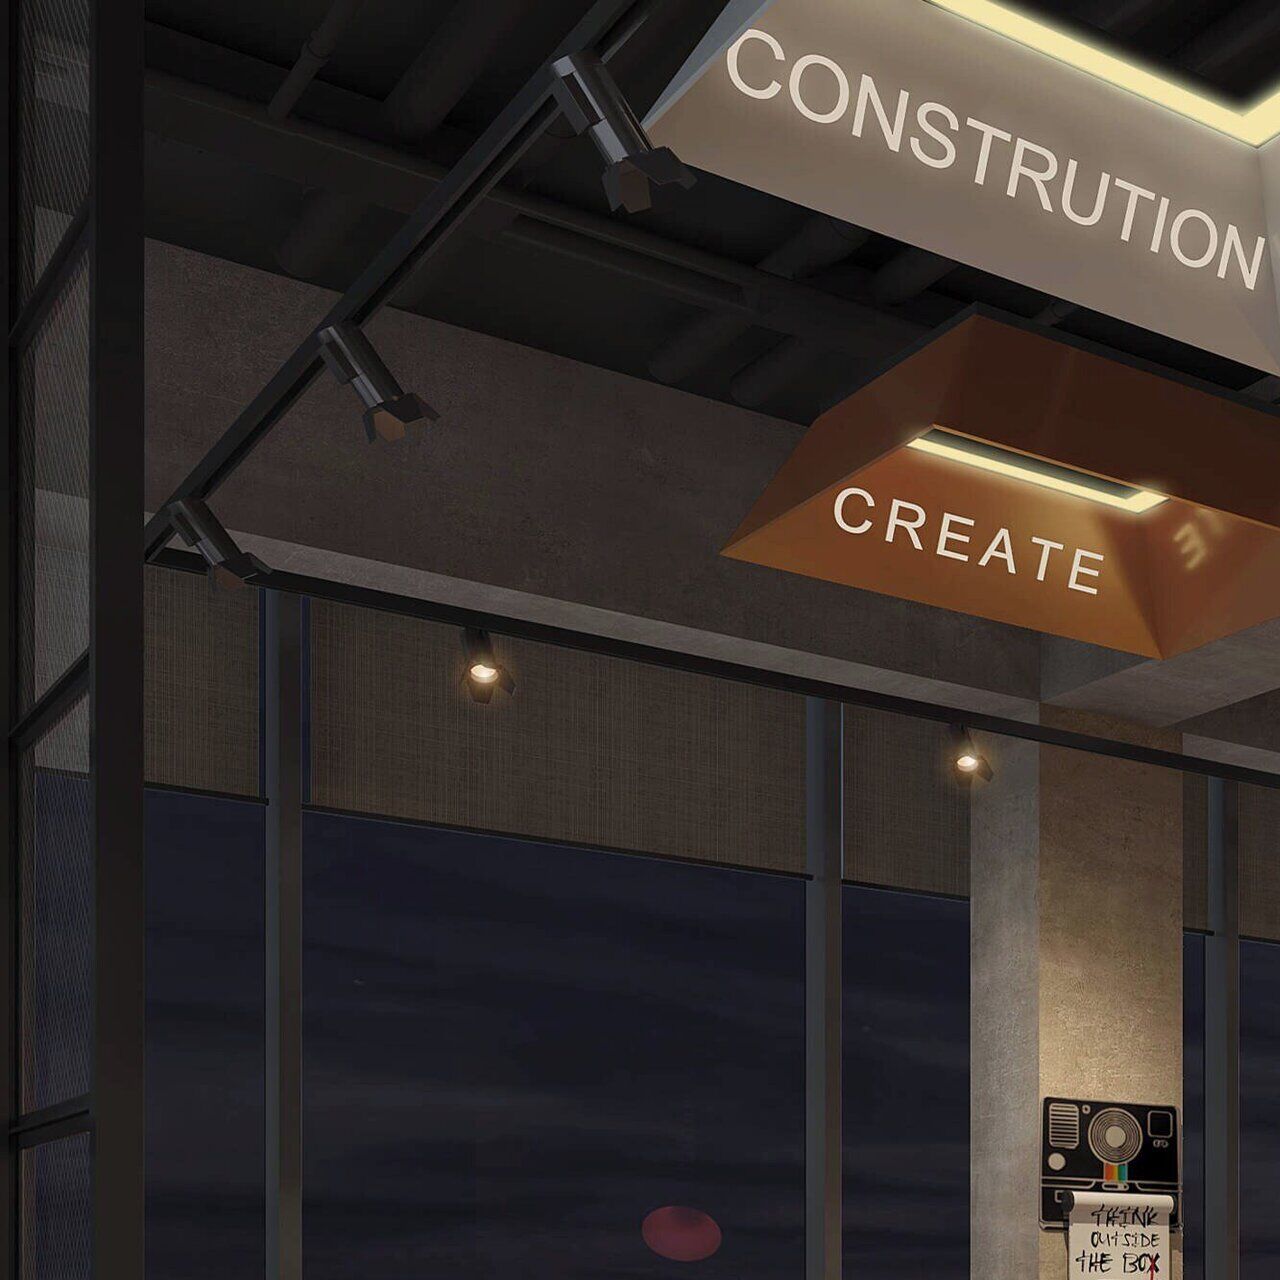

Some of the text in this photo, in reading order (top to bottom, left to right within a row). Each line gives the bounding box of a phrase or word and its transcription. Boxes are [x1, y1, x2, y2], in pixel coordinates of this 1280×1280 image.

[726, 28, 1266, 291] CONSTRUTION
[833, 487, 1105, 595] CREATE
[1122, 1252, 1160, 1274] BOX
